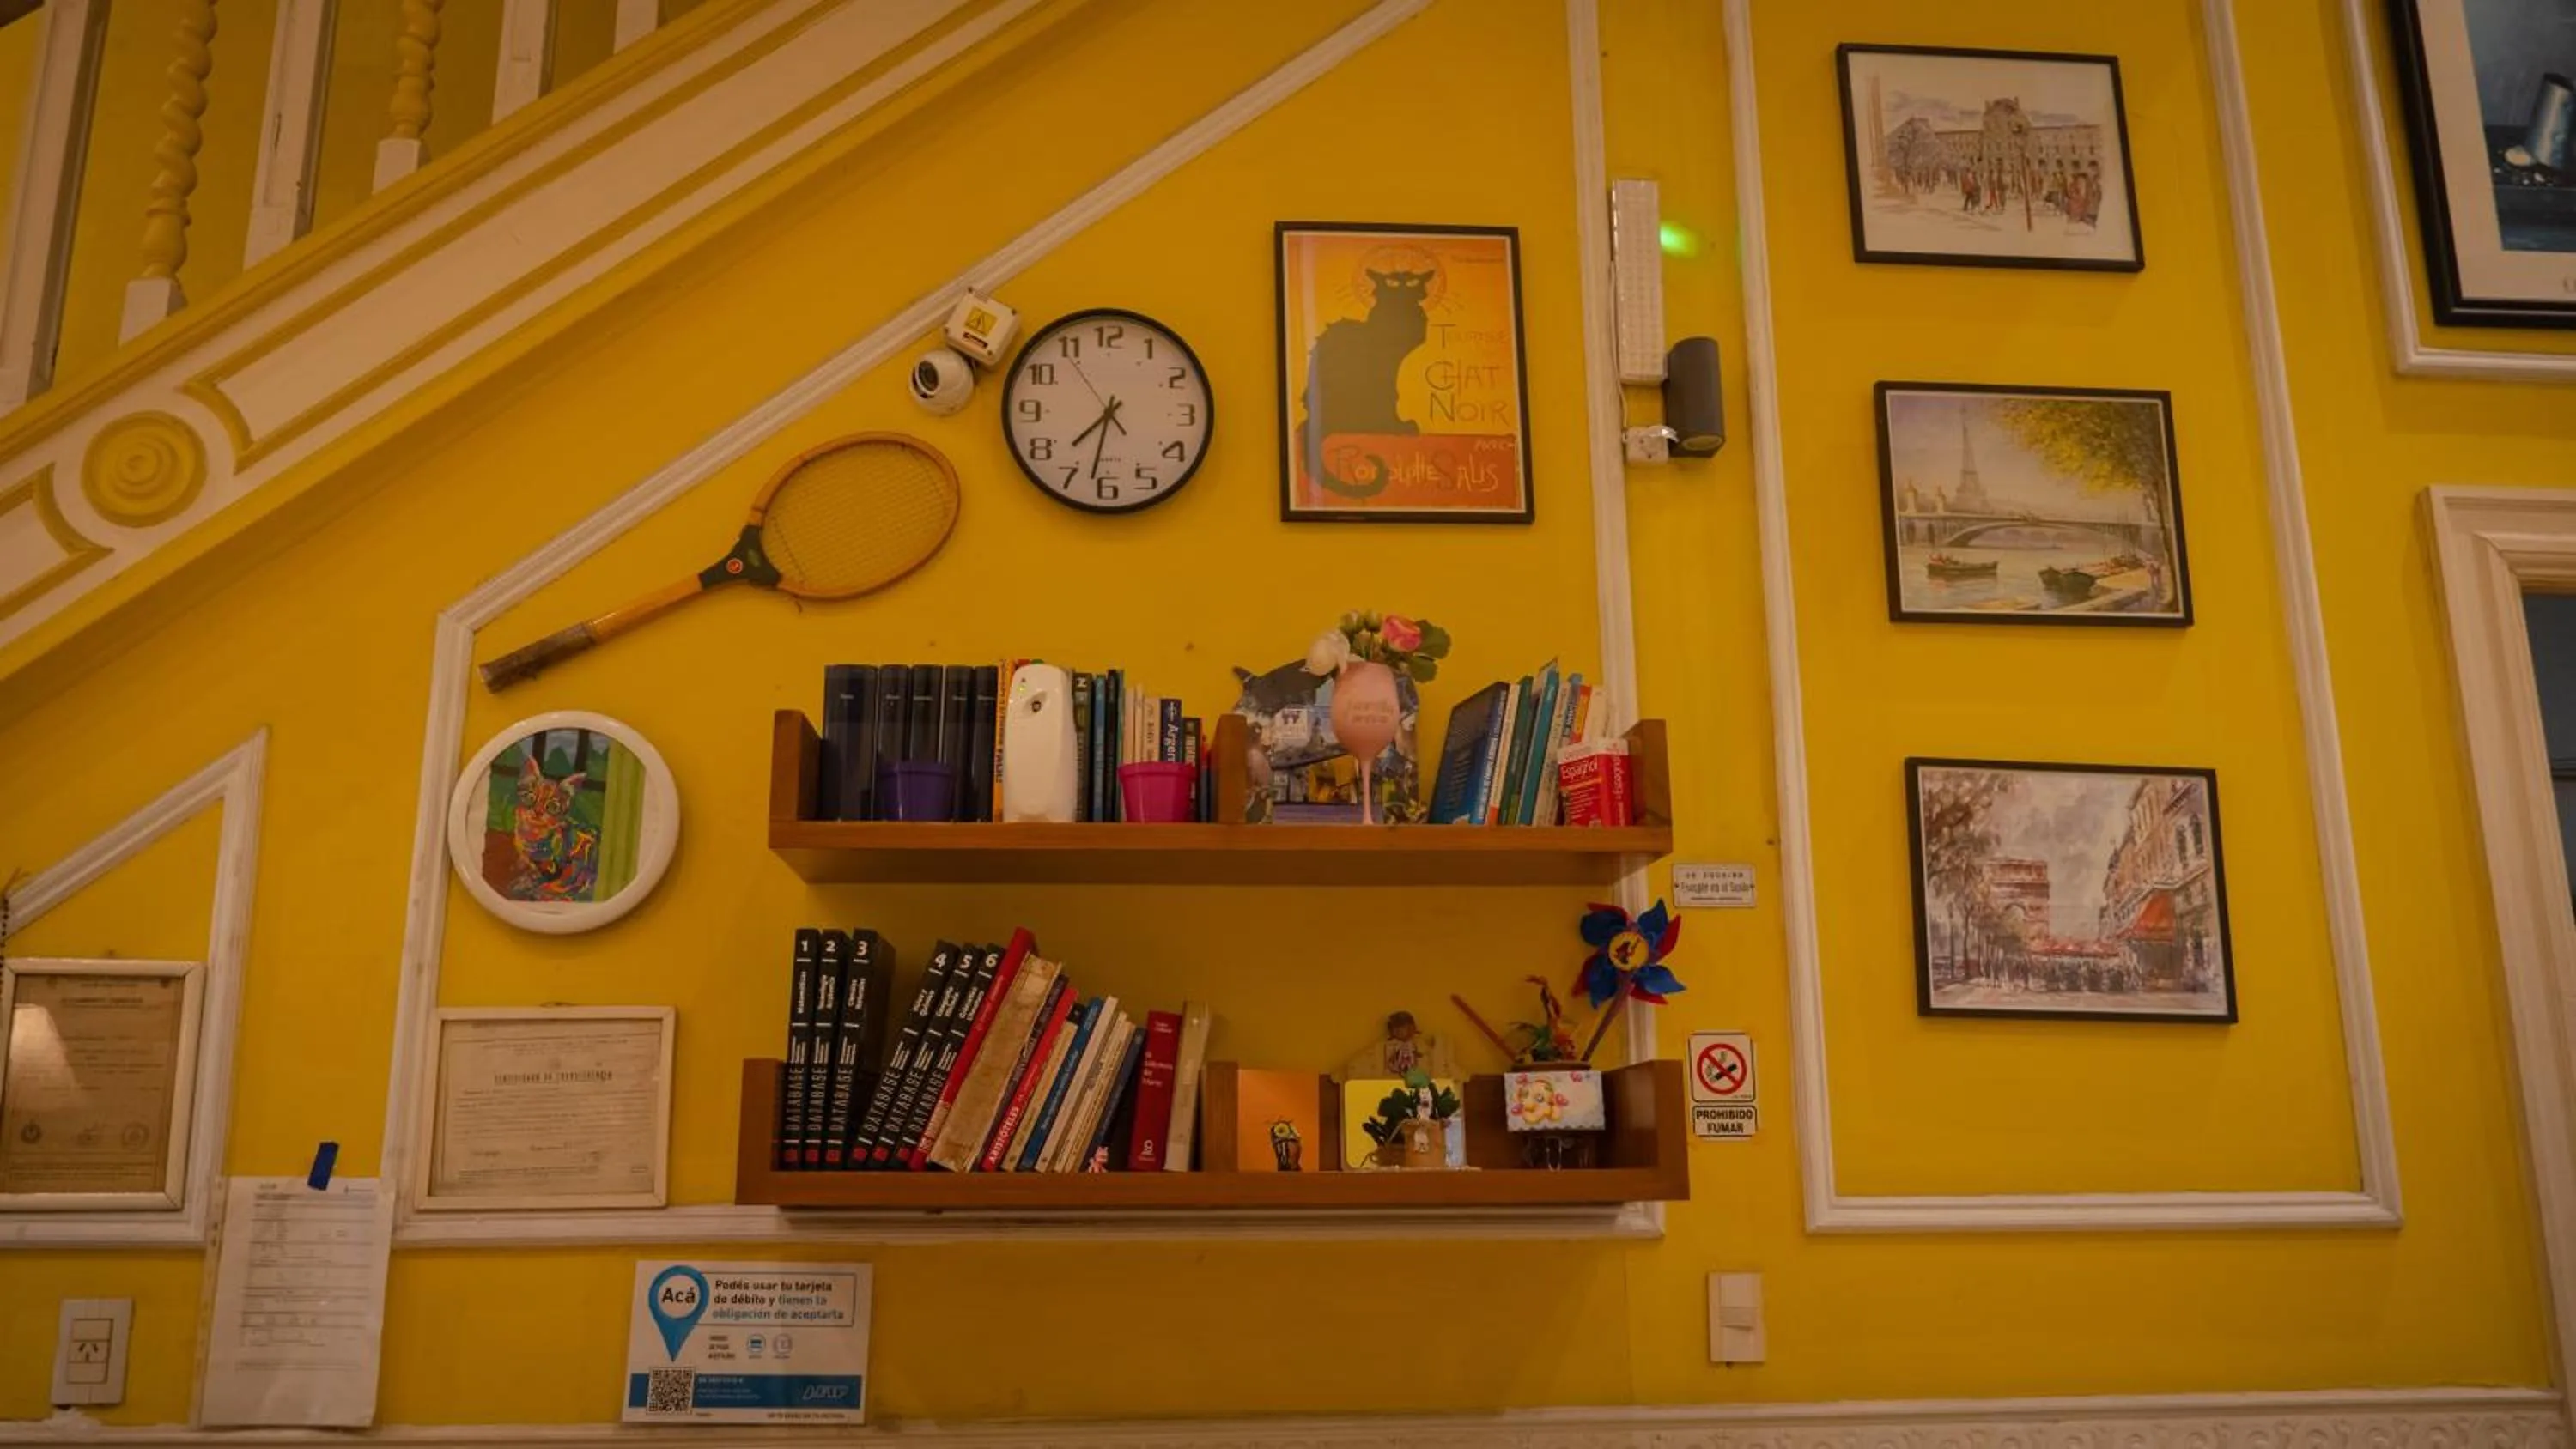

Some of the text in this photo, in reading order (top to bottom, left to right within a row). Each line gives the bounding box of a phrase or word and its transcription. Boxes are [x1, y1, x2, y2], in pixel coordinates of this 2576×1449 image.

[1058, 336, 1080, 358] 11
[1093, 325, 1123, 348] 12
[1144, 337, 1153, 359] 1
[1028, 363, 1054, 385] 10
[1168, 367, 1186, 389] 2
[1425, 358, 1500, 394] CHAT
[1018, 399, 1041, 423] 9
[1176, 403, 1195, 427] 3
[1429, 392, 1510, 426] NOIR
[1030, 437, 1052, 461] 8
[1161, 440, 1185, 462] 4
[1059, 467, 1079, 490] 7
[1097, 476, 1119, 500] 6
[1134, 467, 1157, 490] 5
[1163, 724, 1178, 762] Argen
[801, 940, 808, 951] 1
[826, 940, 836, 952] 2
[858, 941, 868, 955] 3
[934, 952, 947, 967] 4
[959, 955, 973, 969] 5
[985, 952, 999, 968] 6
[786, 1066, 805, 1131] DATABASE
[807, 1066, 828, 1132] DATABASE
[829, 1067, 853, 1132] DATABASE
[863, 1067, 902, 1133] DATABASE
[885, 1066, 925, 1133] DATABASE
[908, 1067, 947, 1134] DATABASE
[1696, 1109, 1753, 1120] PROHIBIDO
[1706, 1123, 1744, 1133] FUMAR
[661, 1287, 696, 1304] Acá
[715, 1279, 833, 1294] Podés usar tu tarjeta
[714, 1293, 827, 1307] de débito y tienen la
[712, 1308, 844, 1322] obligación de aceptarla
